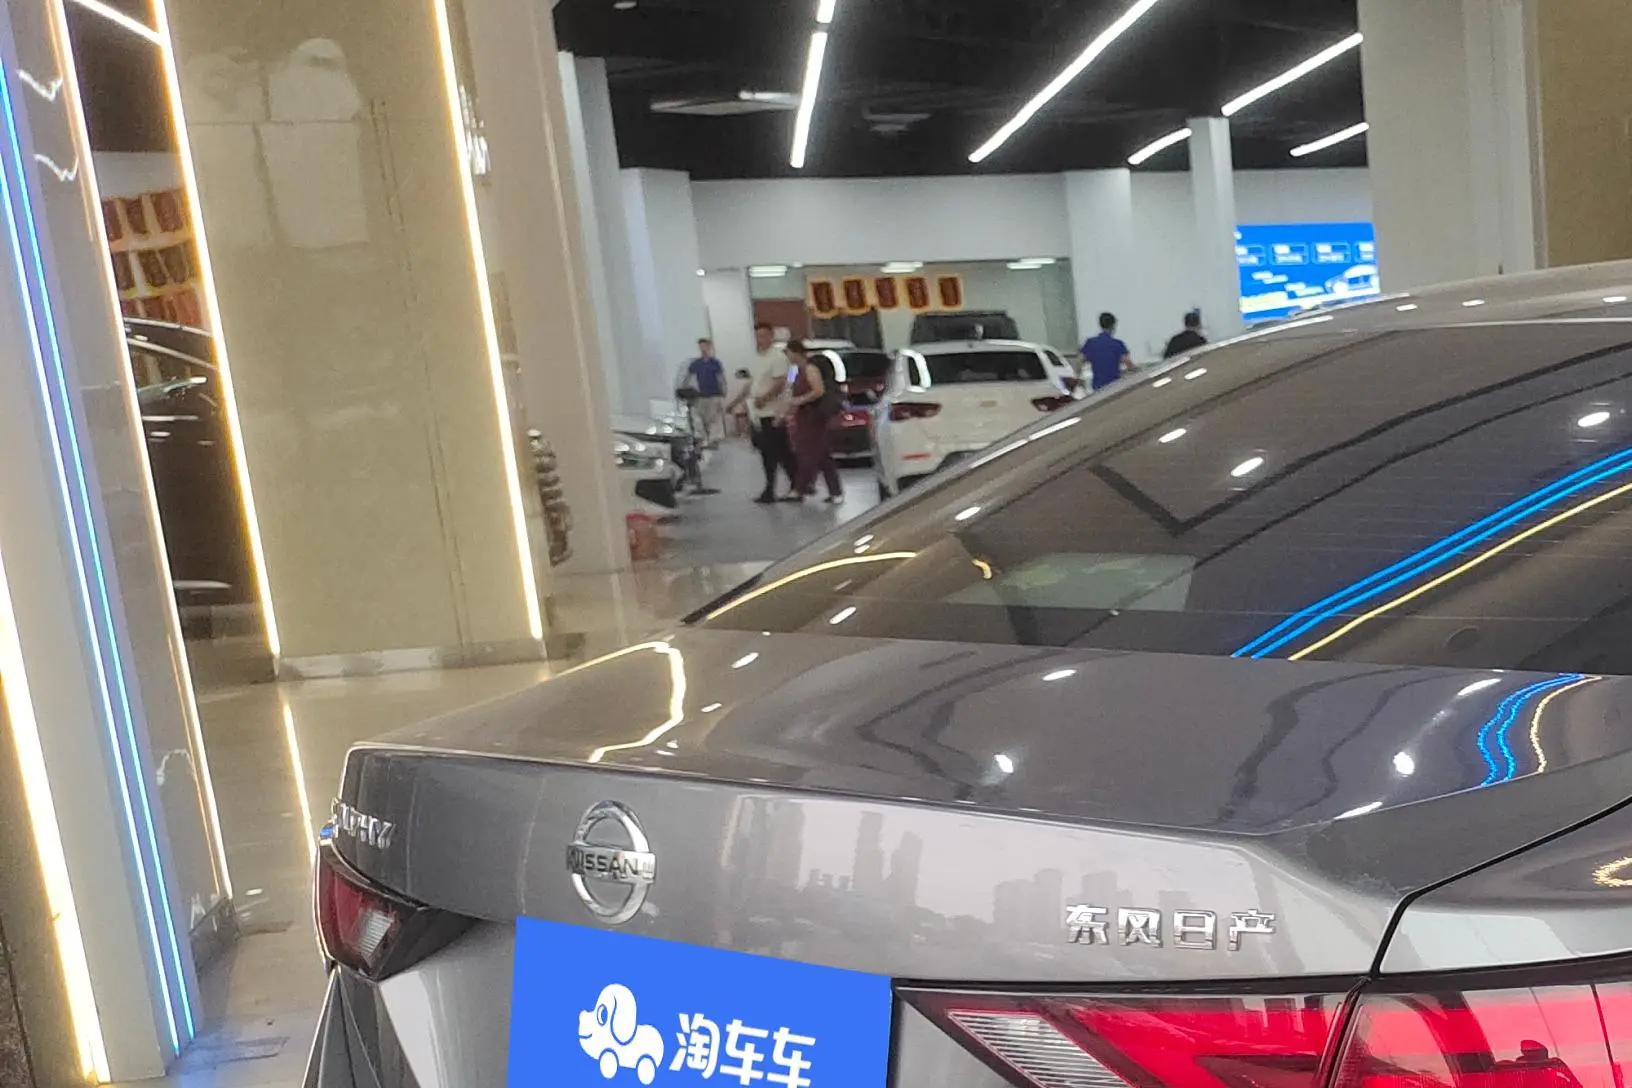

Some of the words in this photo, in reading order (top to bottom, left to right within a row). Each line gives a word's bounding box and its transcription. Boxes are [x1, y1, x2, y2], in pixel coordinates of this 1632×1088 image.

[566, 846, 639, 876] NISSAN
[1065, 903, 1275, 952] 东风日产
